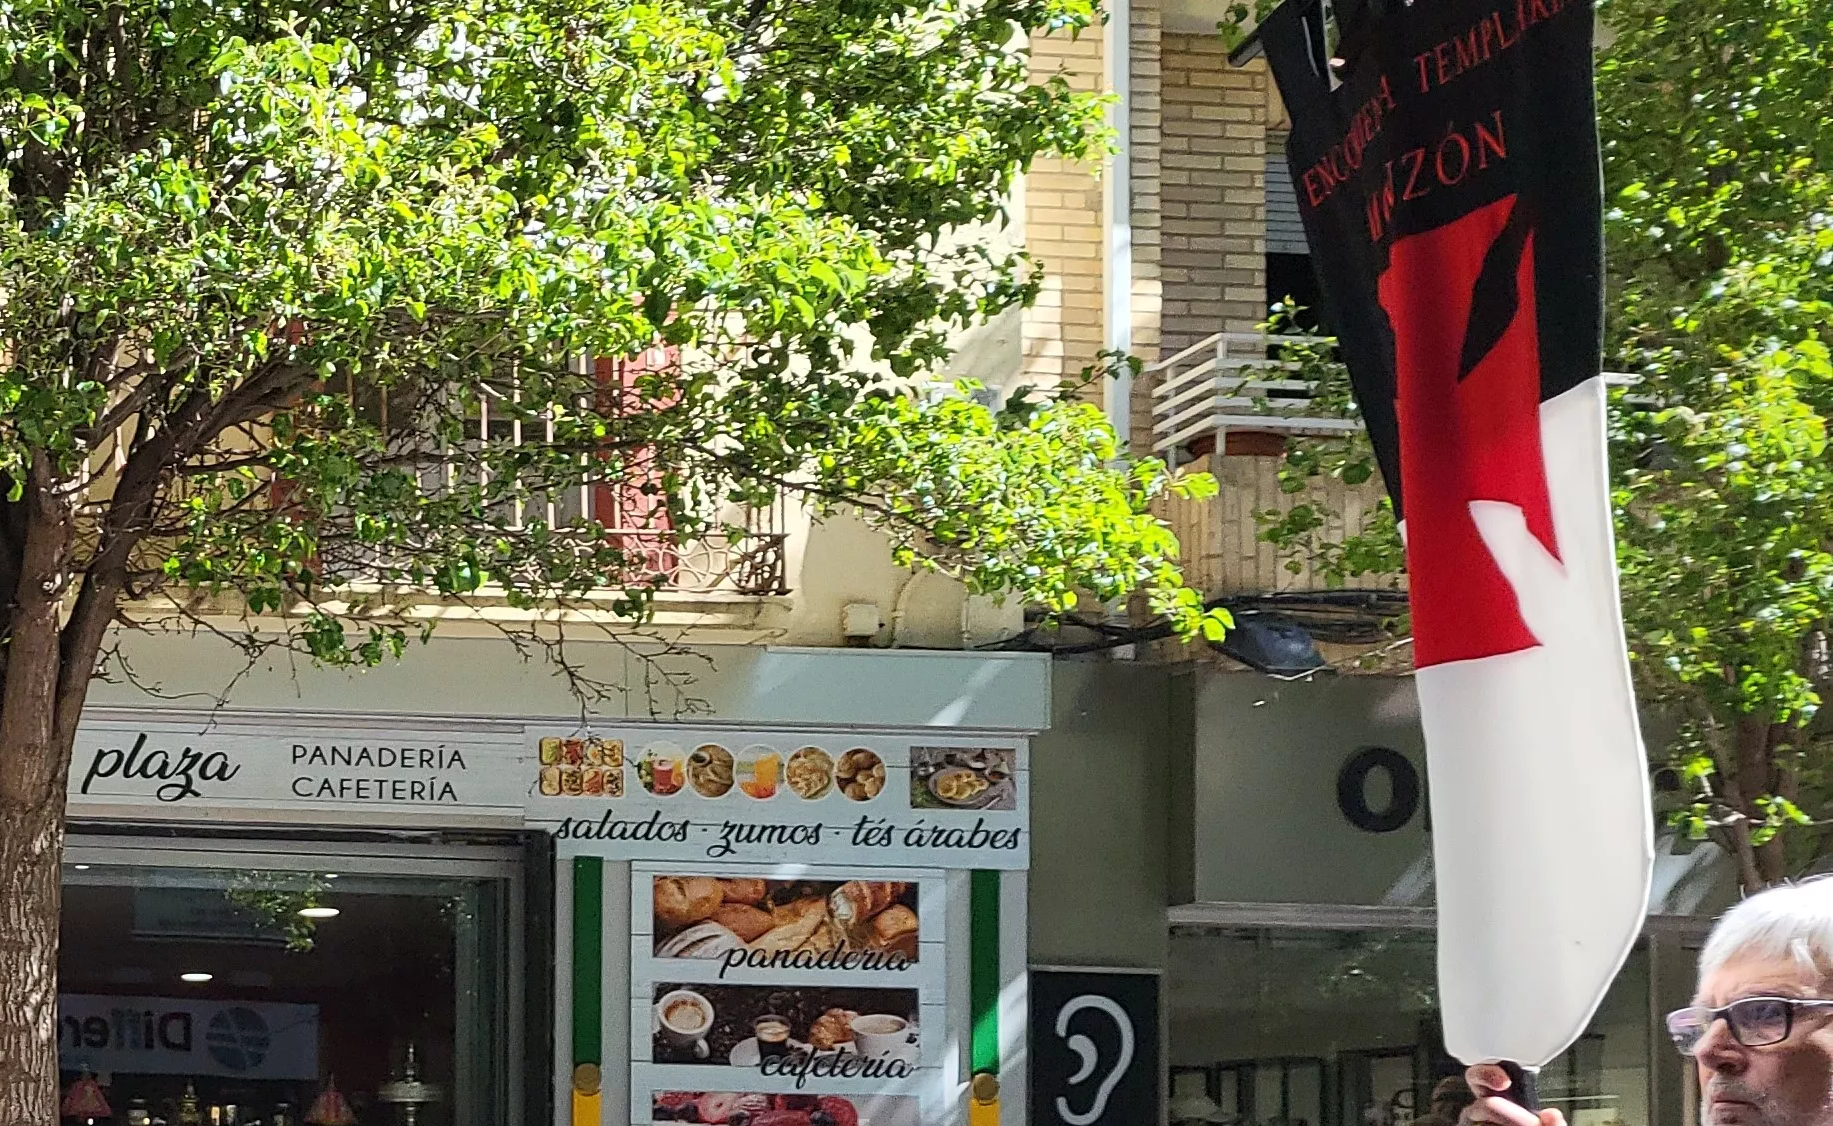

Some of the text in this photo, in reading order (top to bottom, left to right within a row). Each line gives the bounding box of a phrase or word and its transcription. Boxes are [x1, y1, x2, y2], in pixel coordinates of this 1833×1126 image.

[81, 733, 241, 802] plaza
[291, 744, 467, 770] PANADERÍA
[291, 775, 459, 802] CAFETERÍA
[556, 809, 1022, 858] salados zumos tés árabes
[759, 1045, 914, 1090] cafetería
